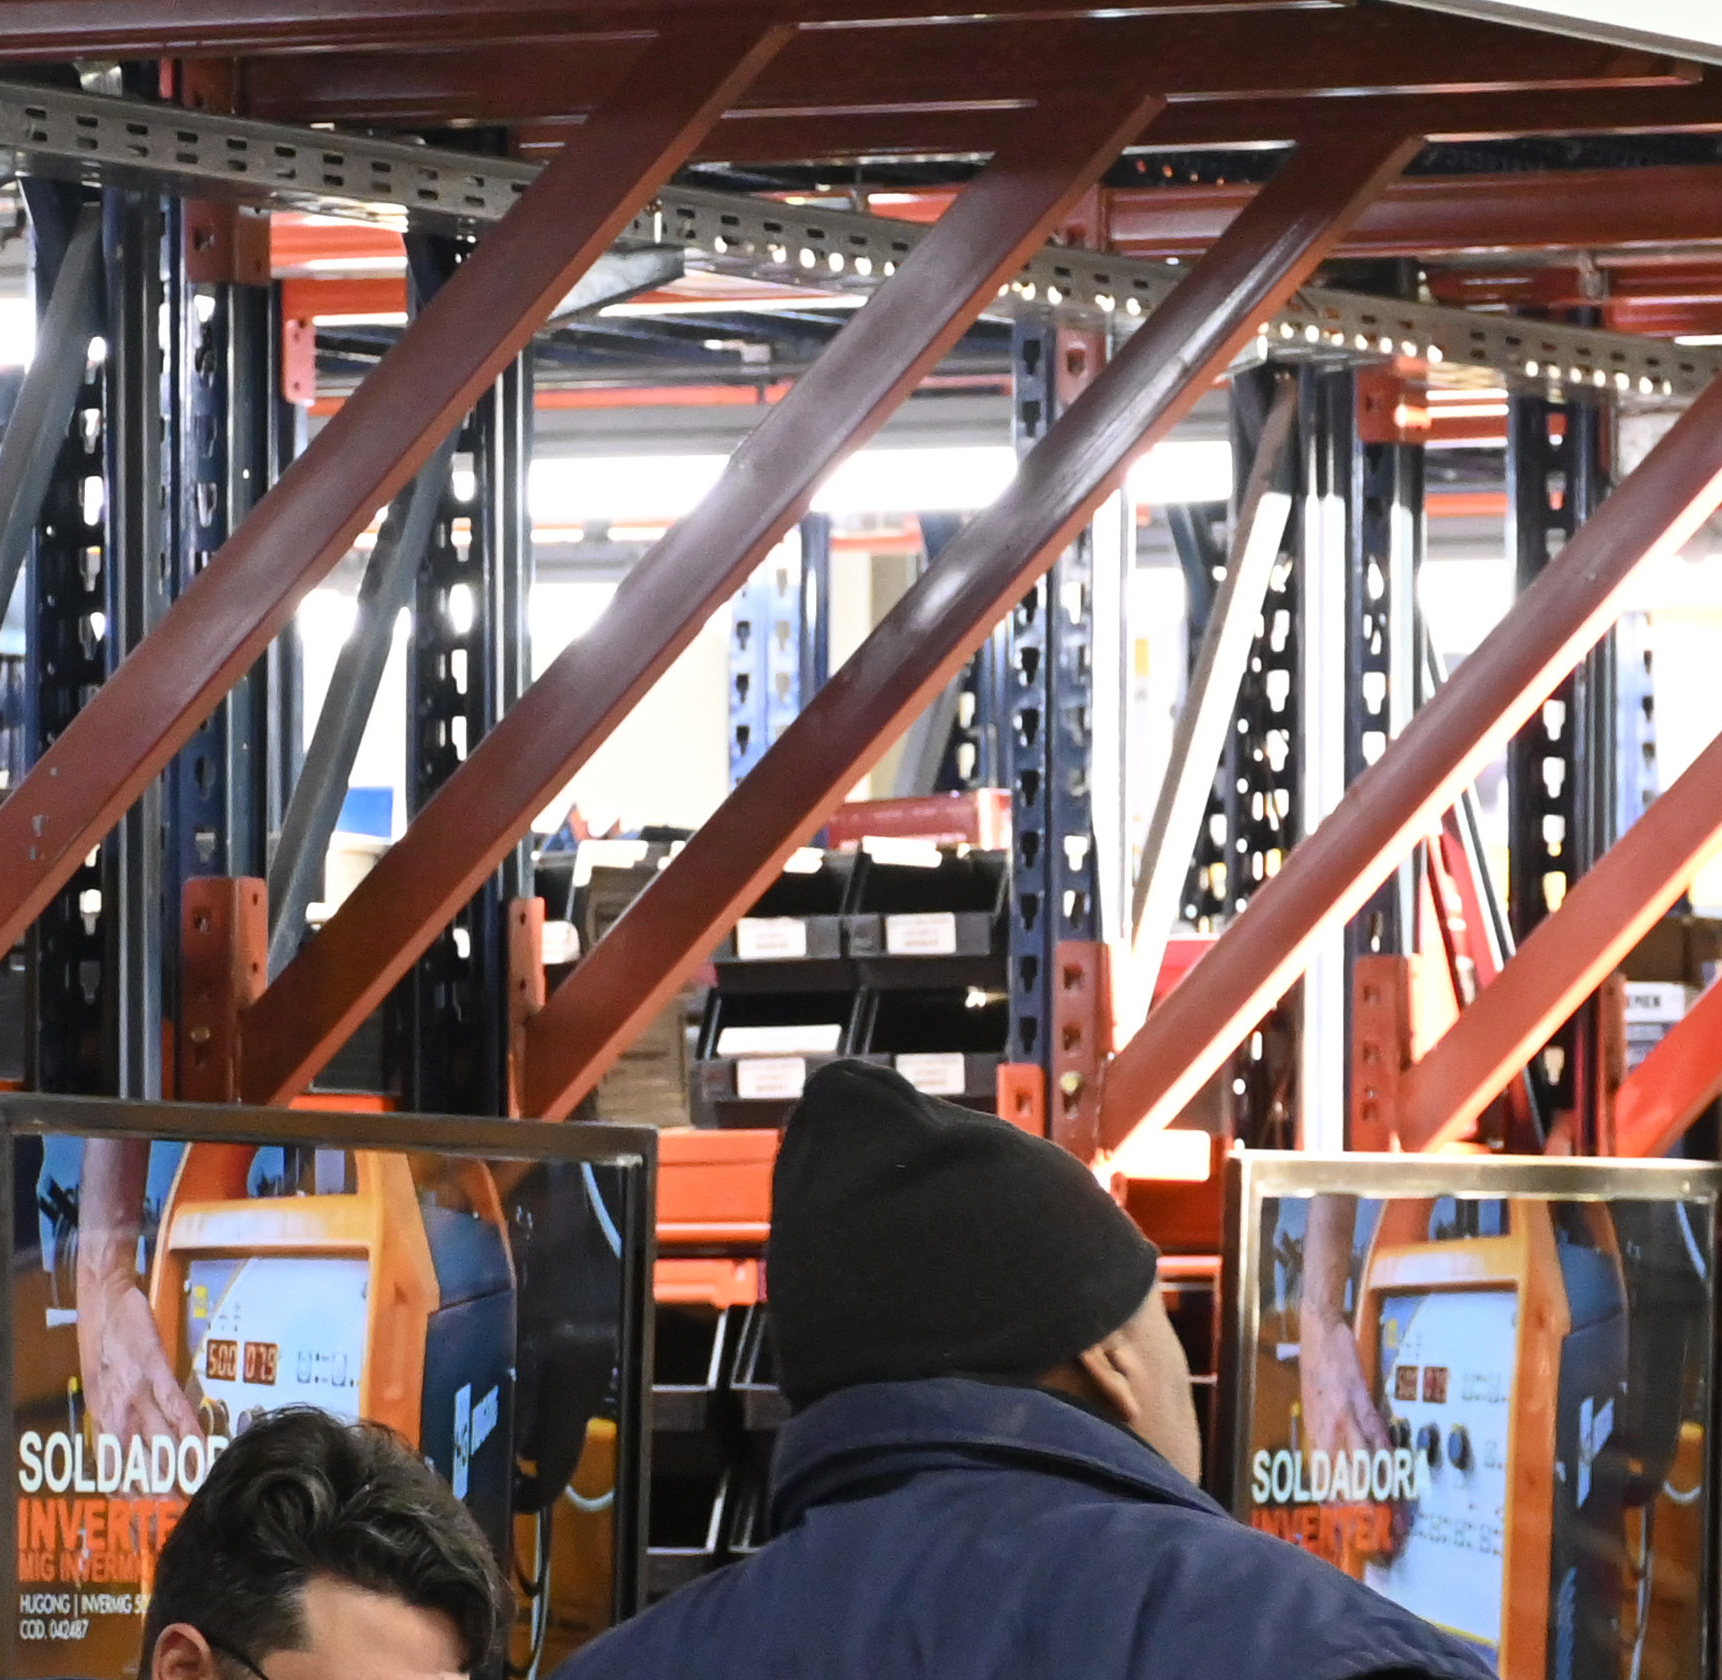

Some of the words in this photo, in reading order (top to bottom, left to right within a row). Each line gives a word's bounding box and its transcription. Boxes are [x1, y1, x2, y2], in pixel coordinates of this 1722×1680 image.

[1251, 1448, 1432, 1503] SOLDADORA
[20, 1594, 71, 1615] HUGONG
[20, 1619, 47, 1640] COD.
